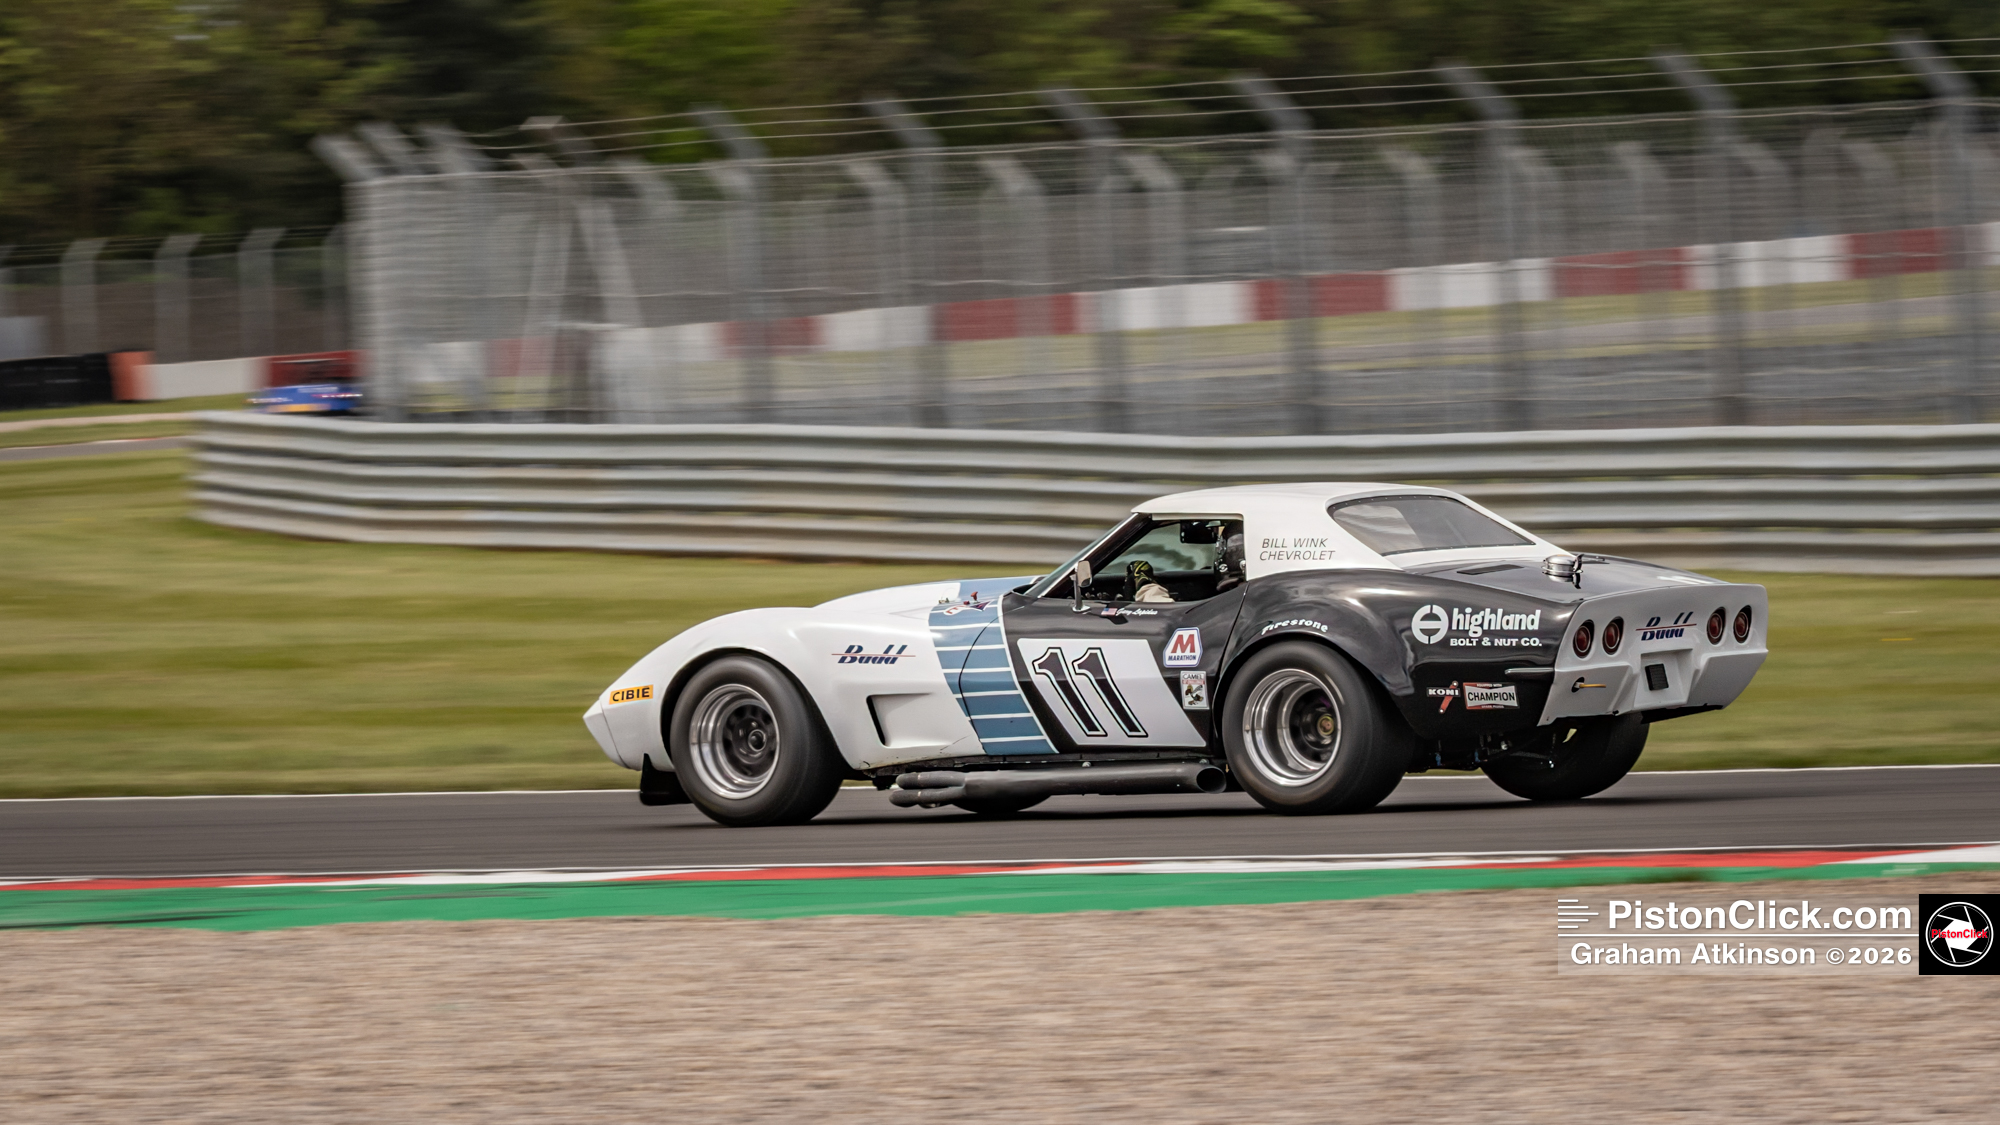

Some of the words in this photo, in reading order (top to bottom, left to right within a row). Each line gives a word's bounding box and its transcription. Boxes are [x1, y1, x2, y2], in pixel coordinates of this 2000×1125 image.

[1261, 538, 1288, 549] BILL
[1293, 537, 1329, 548] WINK
[1259, 550, 1336, 561] CHEVROLET
[1451, 607, 1541, 638] highland
[1641, 611, 1694, 641] Budd
[1171, 634, 1195, 653] M
[1449, 638, 1479, 646] BOLT
[1481, 637, 1491, 646] &
[1494, 638, 1519, 646] NUT
[1520, 637, 1543, 646] CO.
[837, 644, 908, 664] Budd
[612, 687, 650, 702] CIBIE
[1032, 646, 1149, 738] 11
[1428, 688, 1459, 696] KONI
[1467, 692, 1515, 702] CHAMPION
